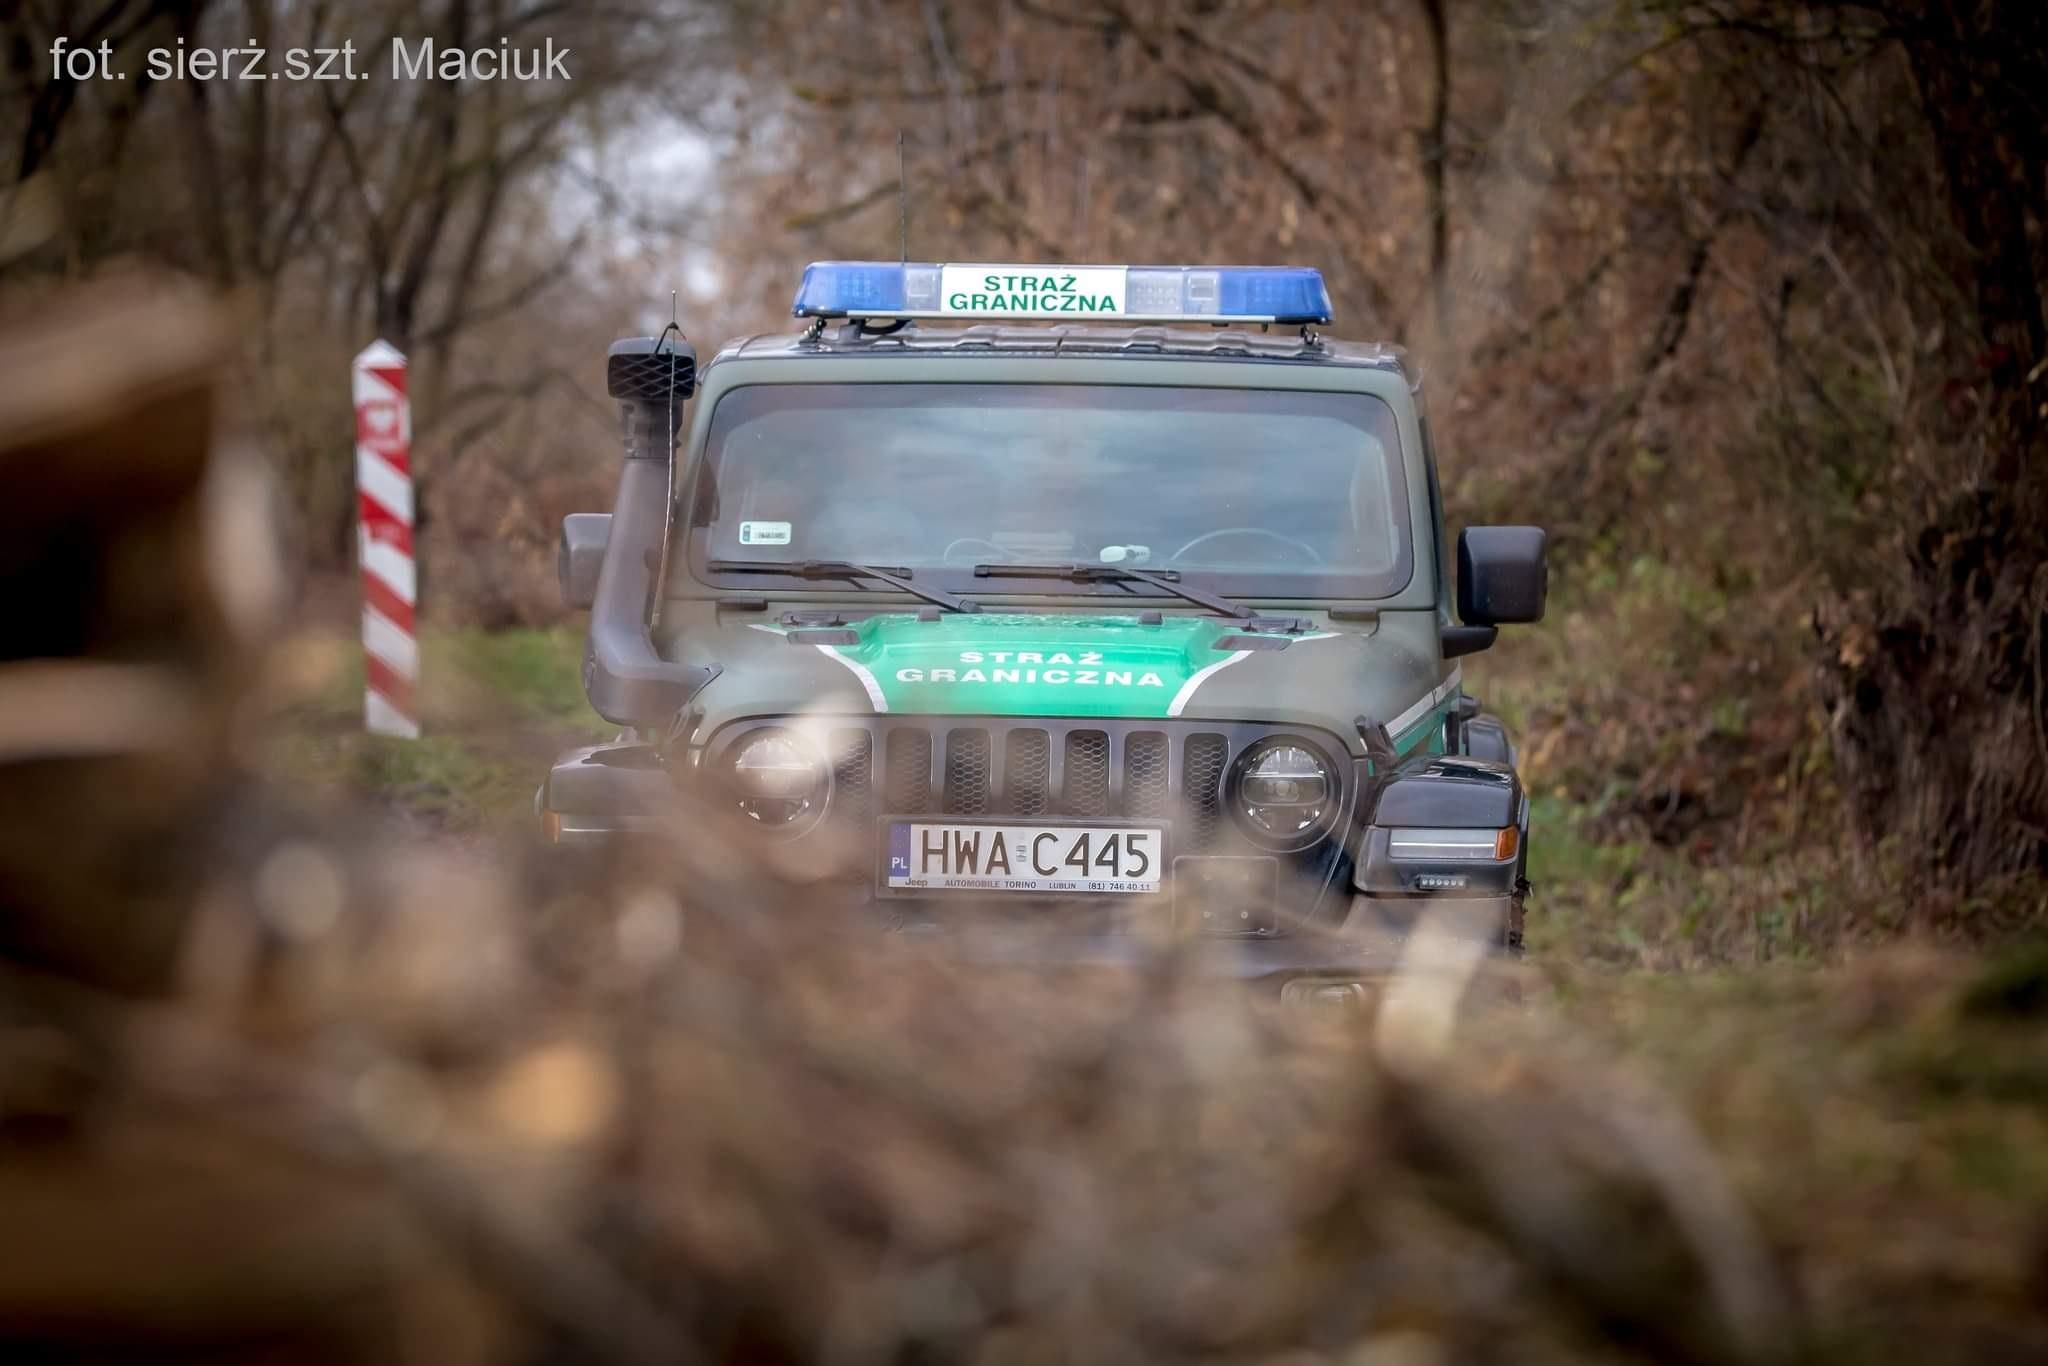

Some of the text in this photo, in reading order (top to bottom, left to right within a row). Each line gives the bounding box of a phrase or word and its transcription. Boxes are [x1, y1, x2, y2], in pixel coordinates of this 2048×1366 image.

[984, 274, 1077, 292] STRAŻ
[949, 293, 1117, 312] GRANICZNA
[959, 650, 1103, 665] STRAŻ
[895, 669, 1164, 687] GRANICZNA
[921, 830, 1149, 877] HWA C445
[891, 857, 908, 869] PL
[905, 877, 928, 888] Jeep
[944, 880, 1001, 888] AUTOMOBILE
[1005, 881, 1036, 889] TORINO
[1049, 882, 1076, 890] LUBLIN
